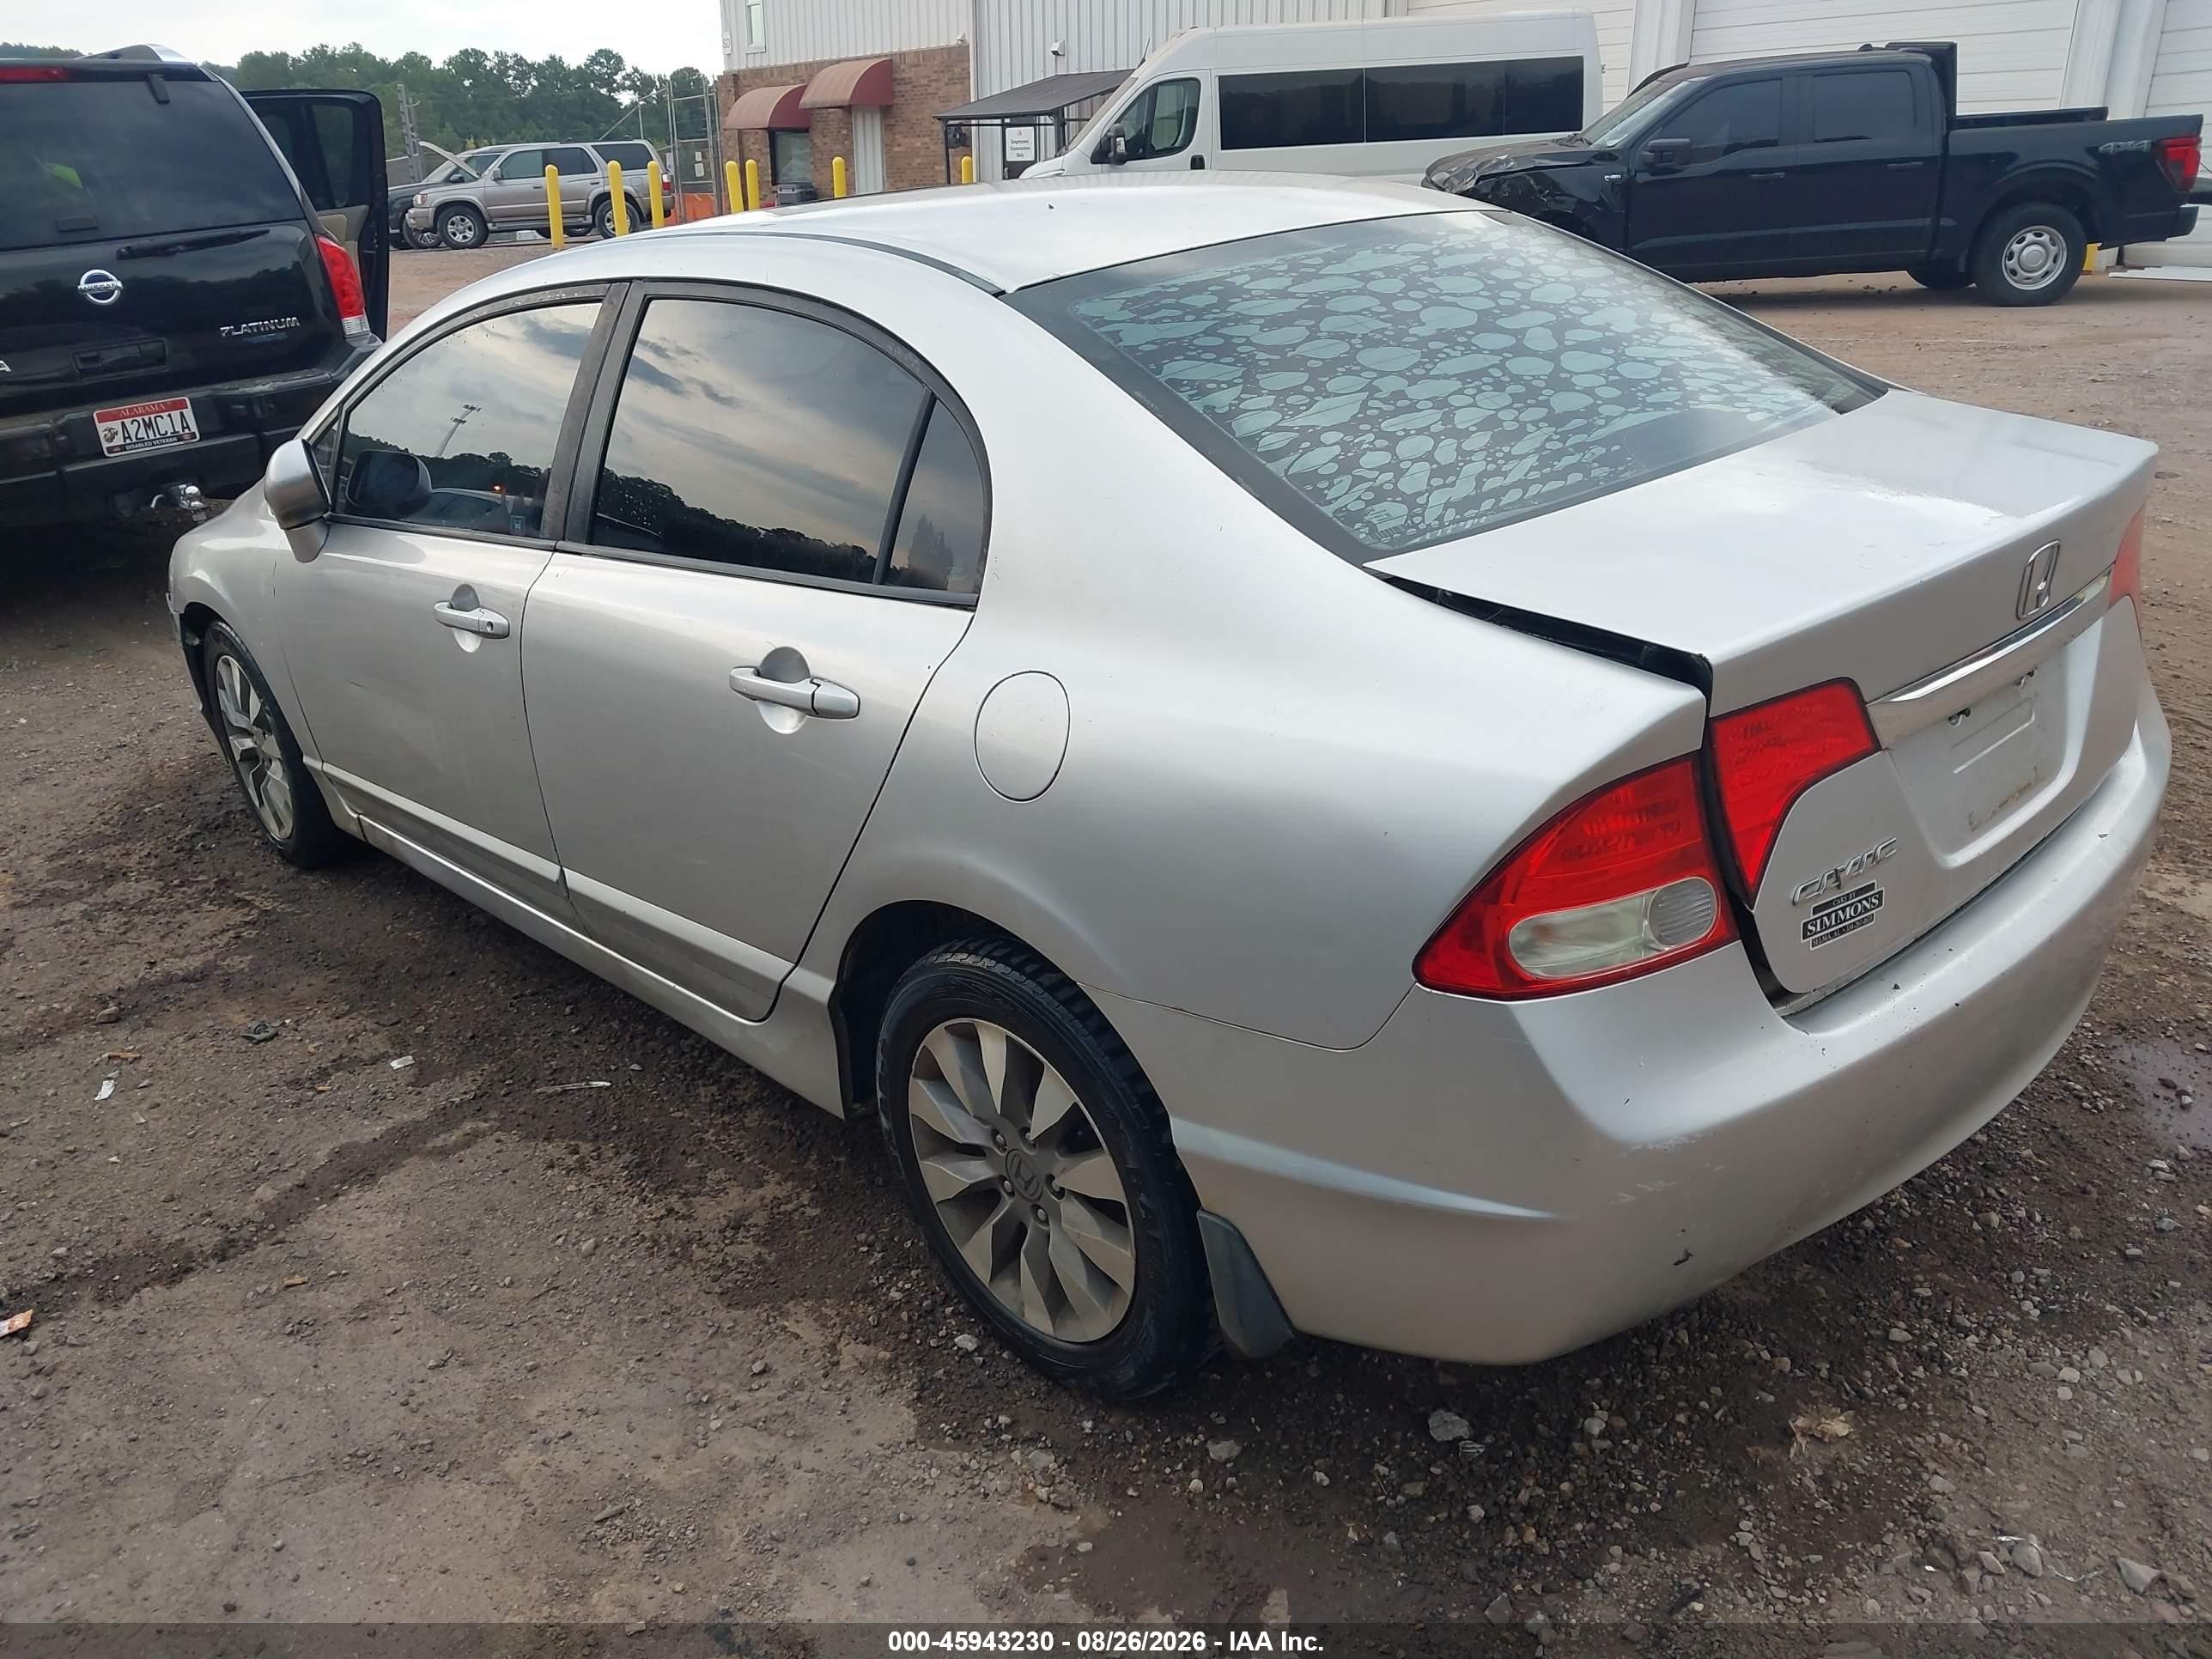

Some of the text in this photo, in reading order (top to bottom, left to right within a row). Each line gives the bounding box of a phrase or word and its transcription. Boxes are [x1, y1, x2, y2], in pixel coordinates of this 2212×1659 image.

[220, 317, 301, 337] PLATINUM
[120, 403, 166, 417] ALABAMA
[121, 411, 191, 443] A2MC1A
[125, 436, 178, 451] DISABLED VETERAN
[1792, 836, 1898, 906] CIVIC
[1832, 895, 1848, 907] CARS
[1806, 894, 1880, 936] SIMMONS
